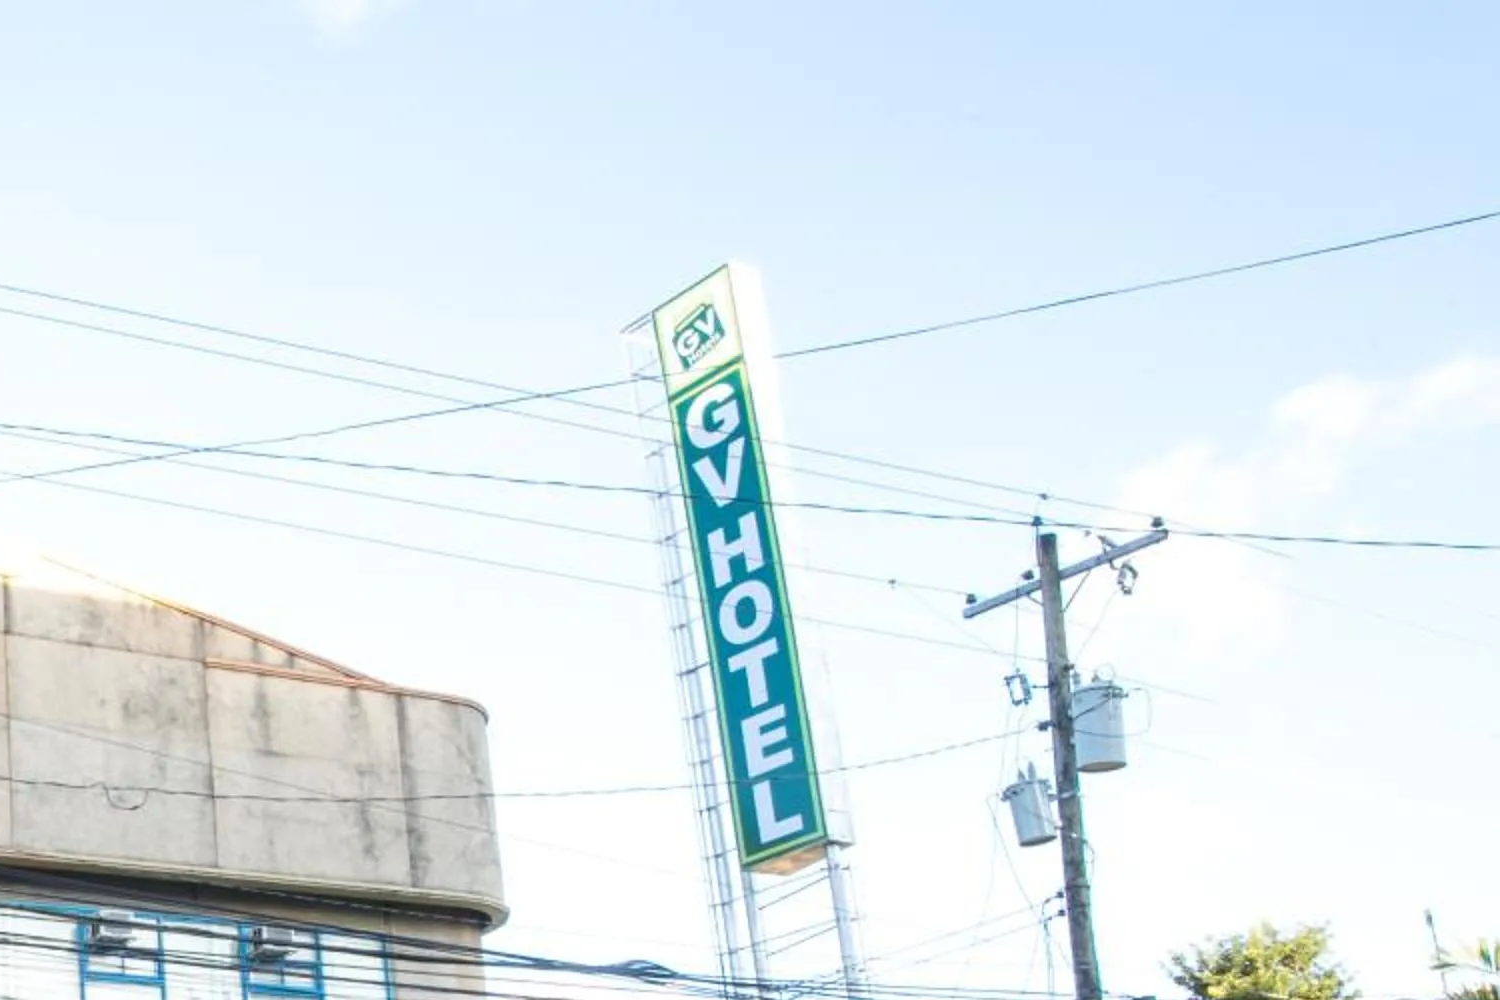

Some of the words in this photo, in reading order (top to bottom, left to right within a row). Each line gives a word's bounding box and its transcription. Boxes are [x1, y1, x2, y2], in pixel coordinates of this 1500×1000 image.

[677, 305, 716, 357] GV
[686, 382, 746, 508] GV
[707, 511, 804, 845] HOTEL
